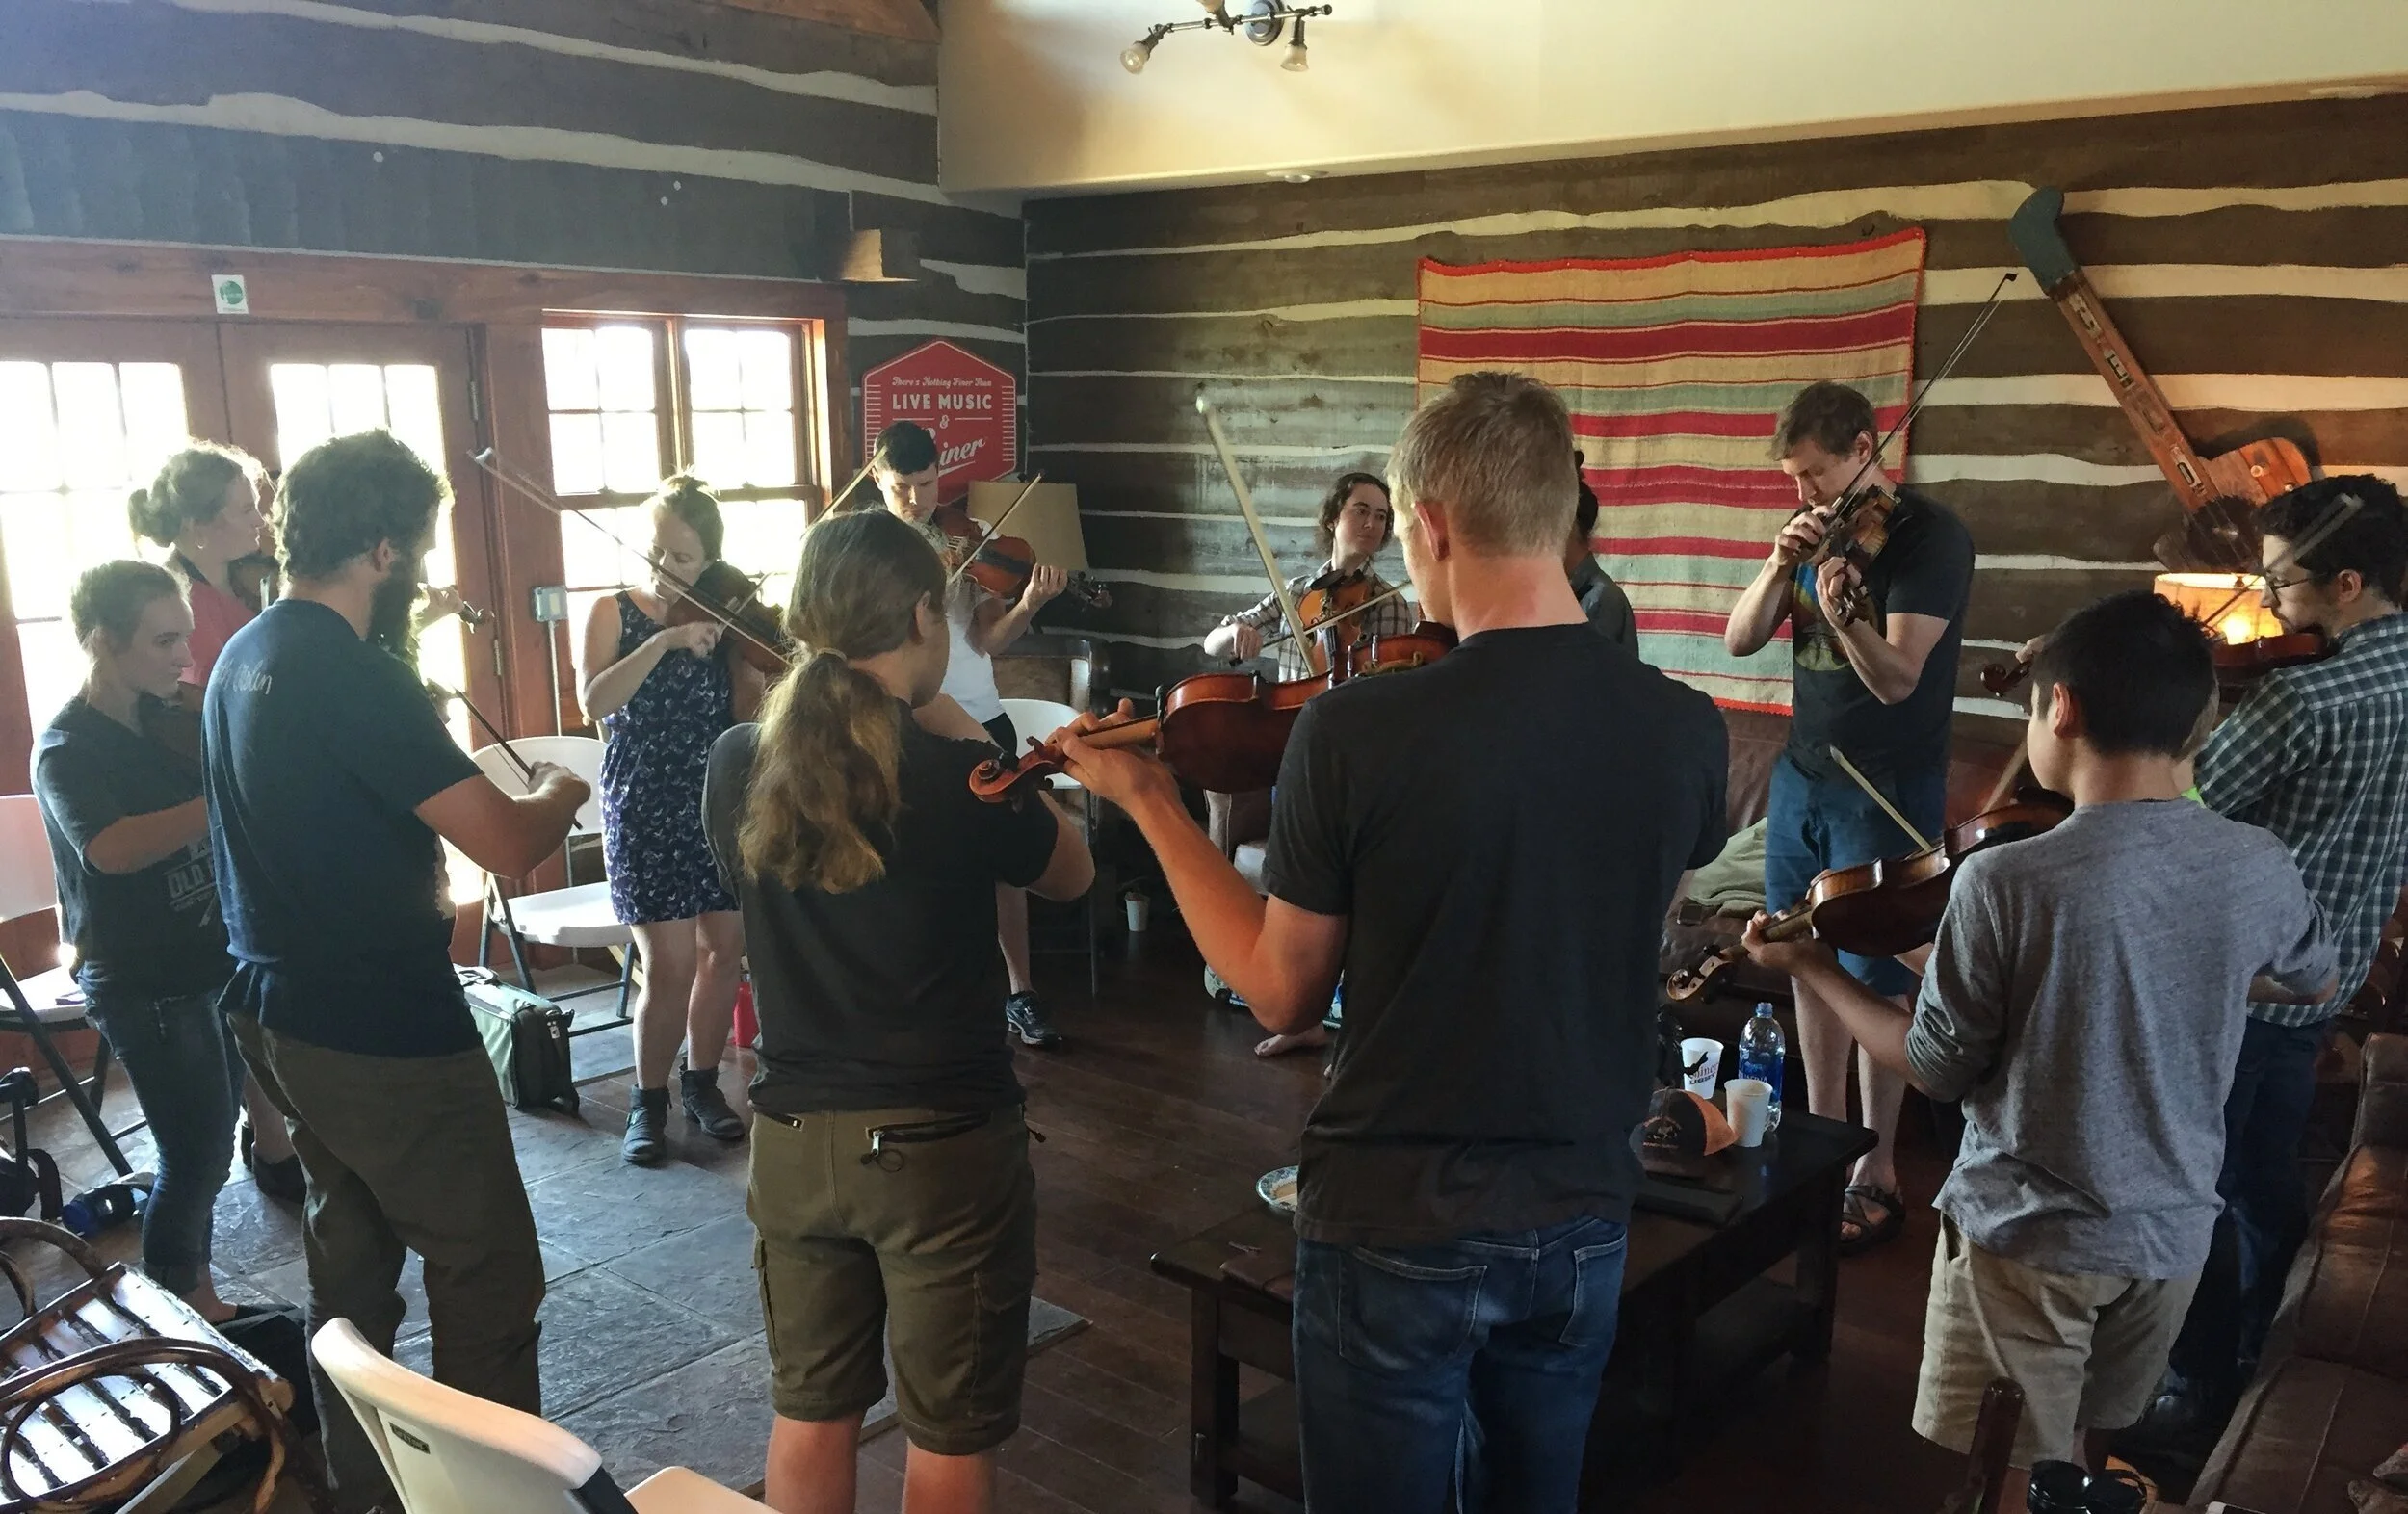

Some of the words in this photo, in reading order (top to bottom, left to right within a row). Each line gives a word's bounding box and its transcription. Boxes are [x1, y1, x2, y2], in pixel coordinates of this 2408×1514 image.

[923, 376, 951, 389] Nothing
[953, 377, 974, 387] Finer
[975, 377, 992, 387] Than
[892, 393, 931, 410] LIVE
[938, 393, 992, 410] MUSIC
[939, 415, 949, 430] &
